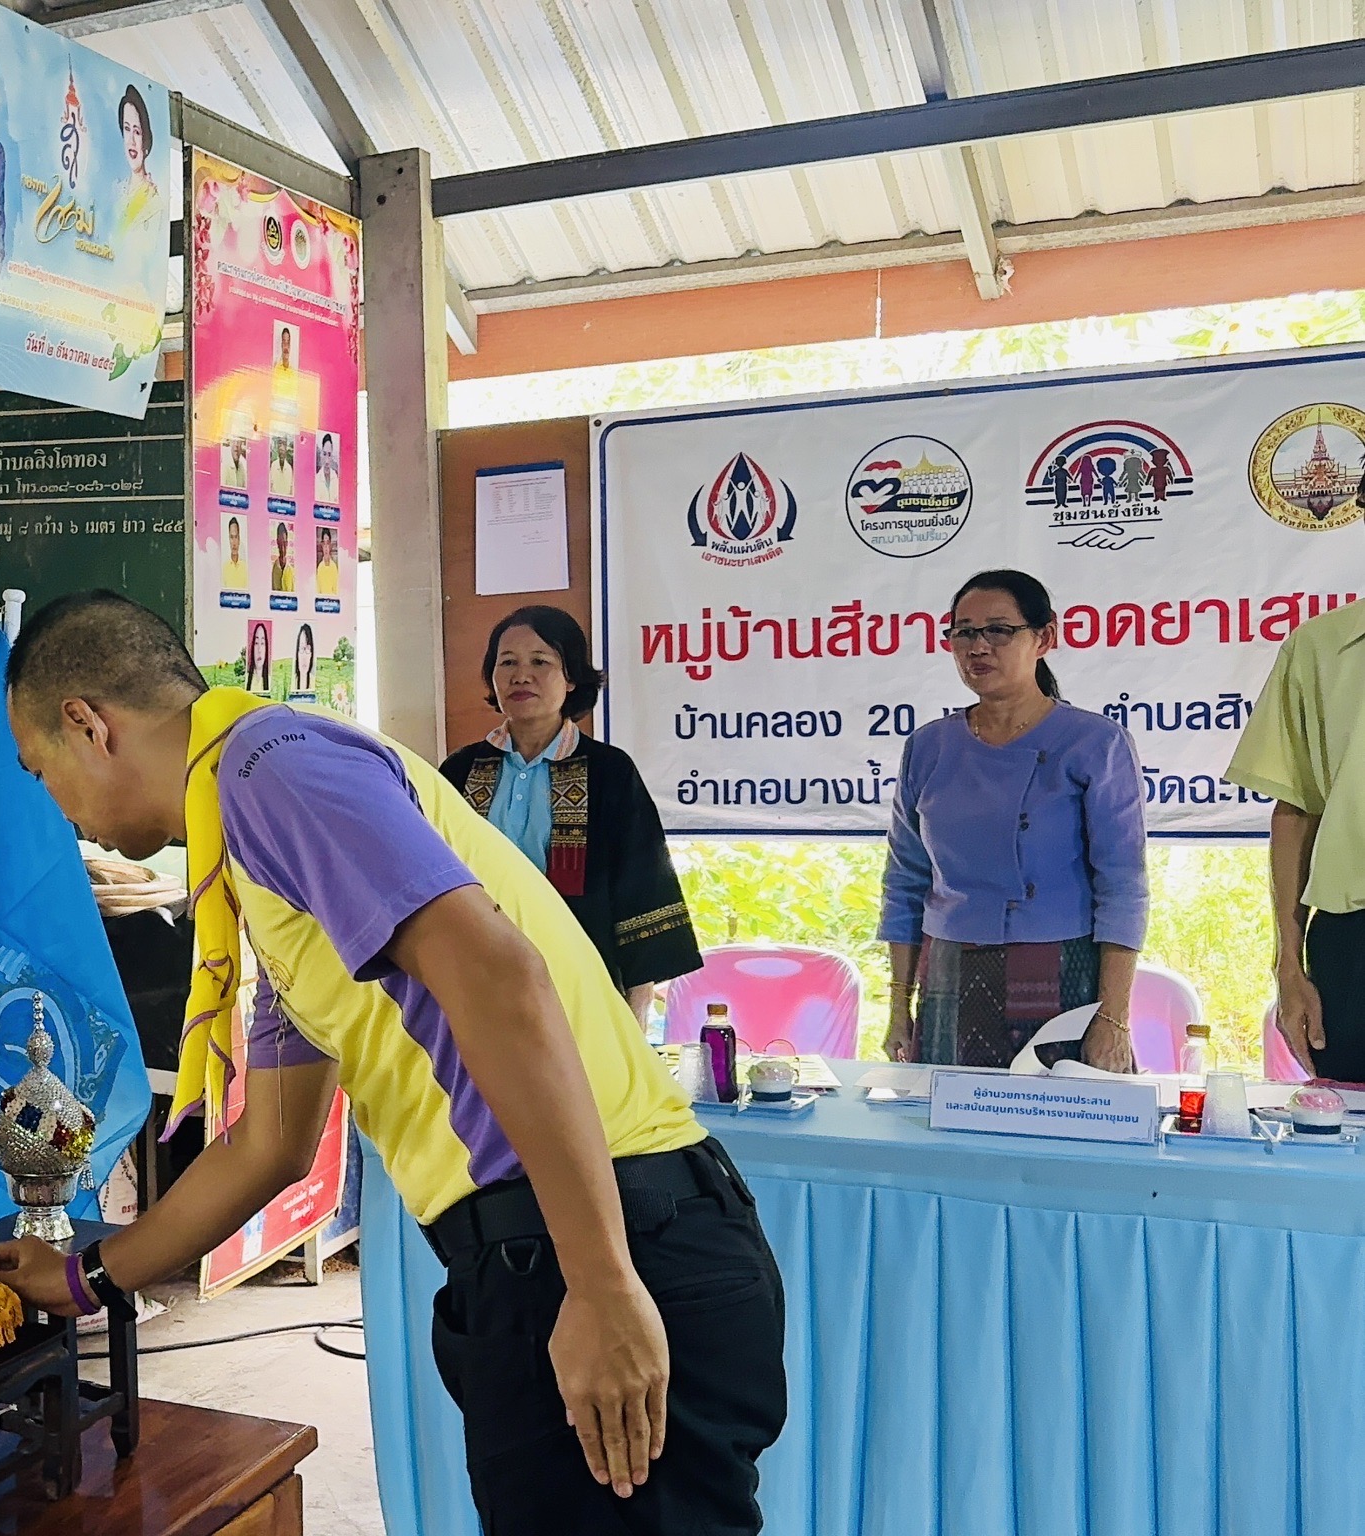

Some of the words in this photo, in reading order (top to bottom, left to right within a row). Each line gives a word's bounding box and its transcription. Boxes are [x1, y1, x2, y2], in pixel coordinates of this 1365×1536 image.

[26, 331, 45, 354] วันที่
[55, 341, 90, 364] ธันวาคม
[35, 516, 63, 535] กว้าง
[85, 518, 115, 534] เมตร
[123, 519, 146, 533] ยาว
[861, 514, 959, 532] โครงการชุมชนยั่งยืน
[1052, 502, 1161, 527] ชุมชนยั่งยืน
[711, 538, 774, 555] พลังแผ่นดิน
[675, 704, 841, 740] บ้านคลอง
[868, 704, 915, 737] 20
[237, 738, 280, 779] จิตอาสา
[281, 733, 306, 743] 904
[973, 1087, 1111, 1107] ผู้อำนวยการกลุ่มงานประสาน
[945, 1101, 1139, 1125] และสนับสนุนการบริหารงานพัฒนาชุมชน
